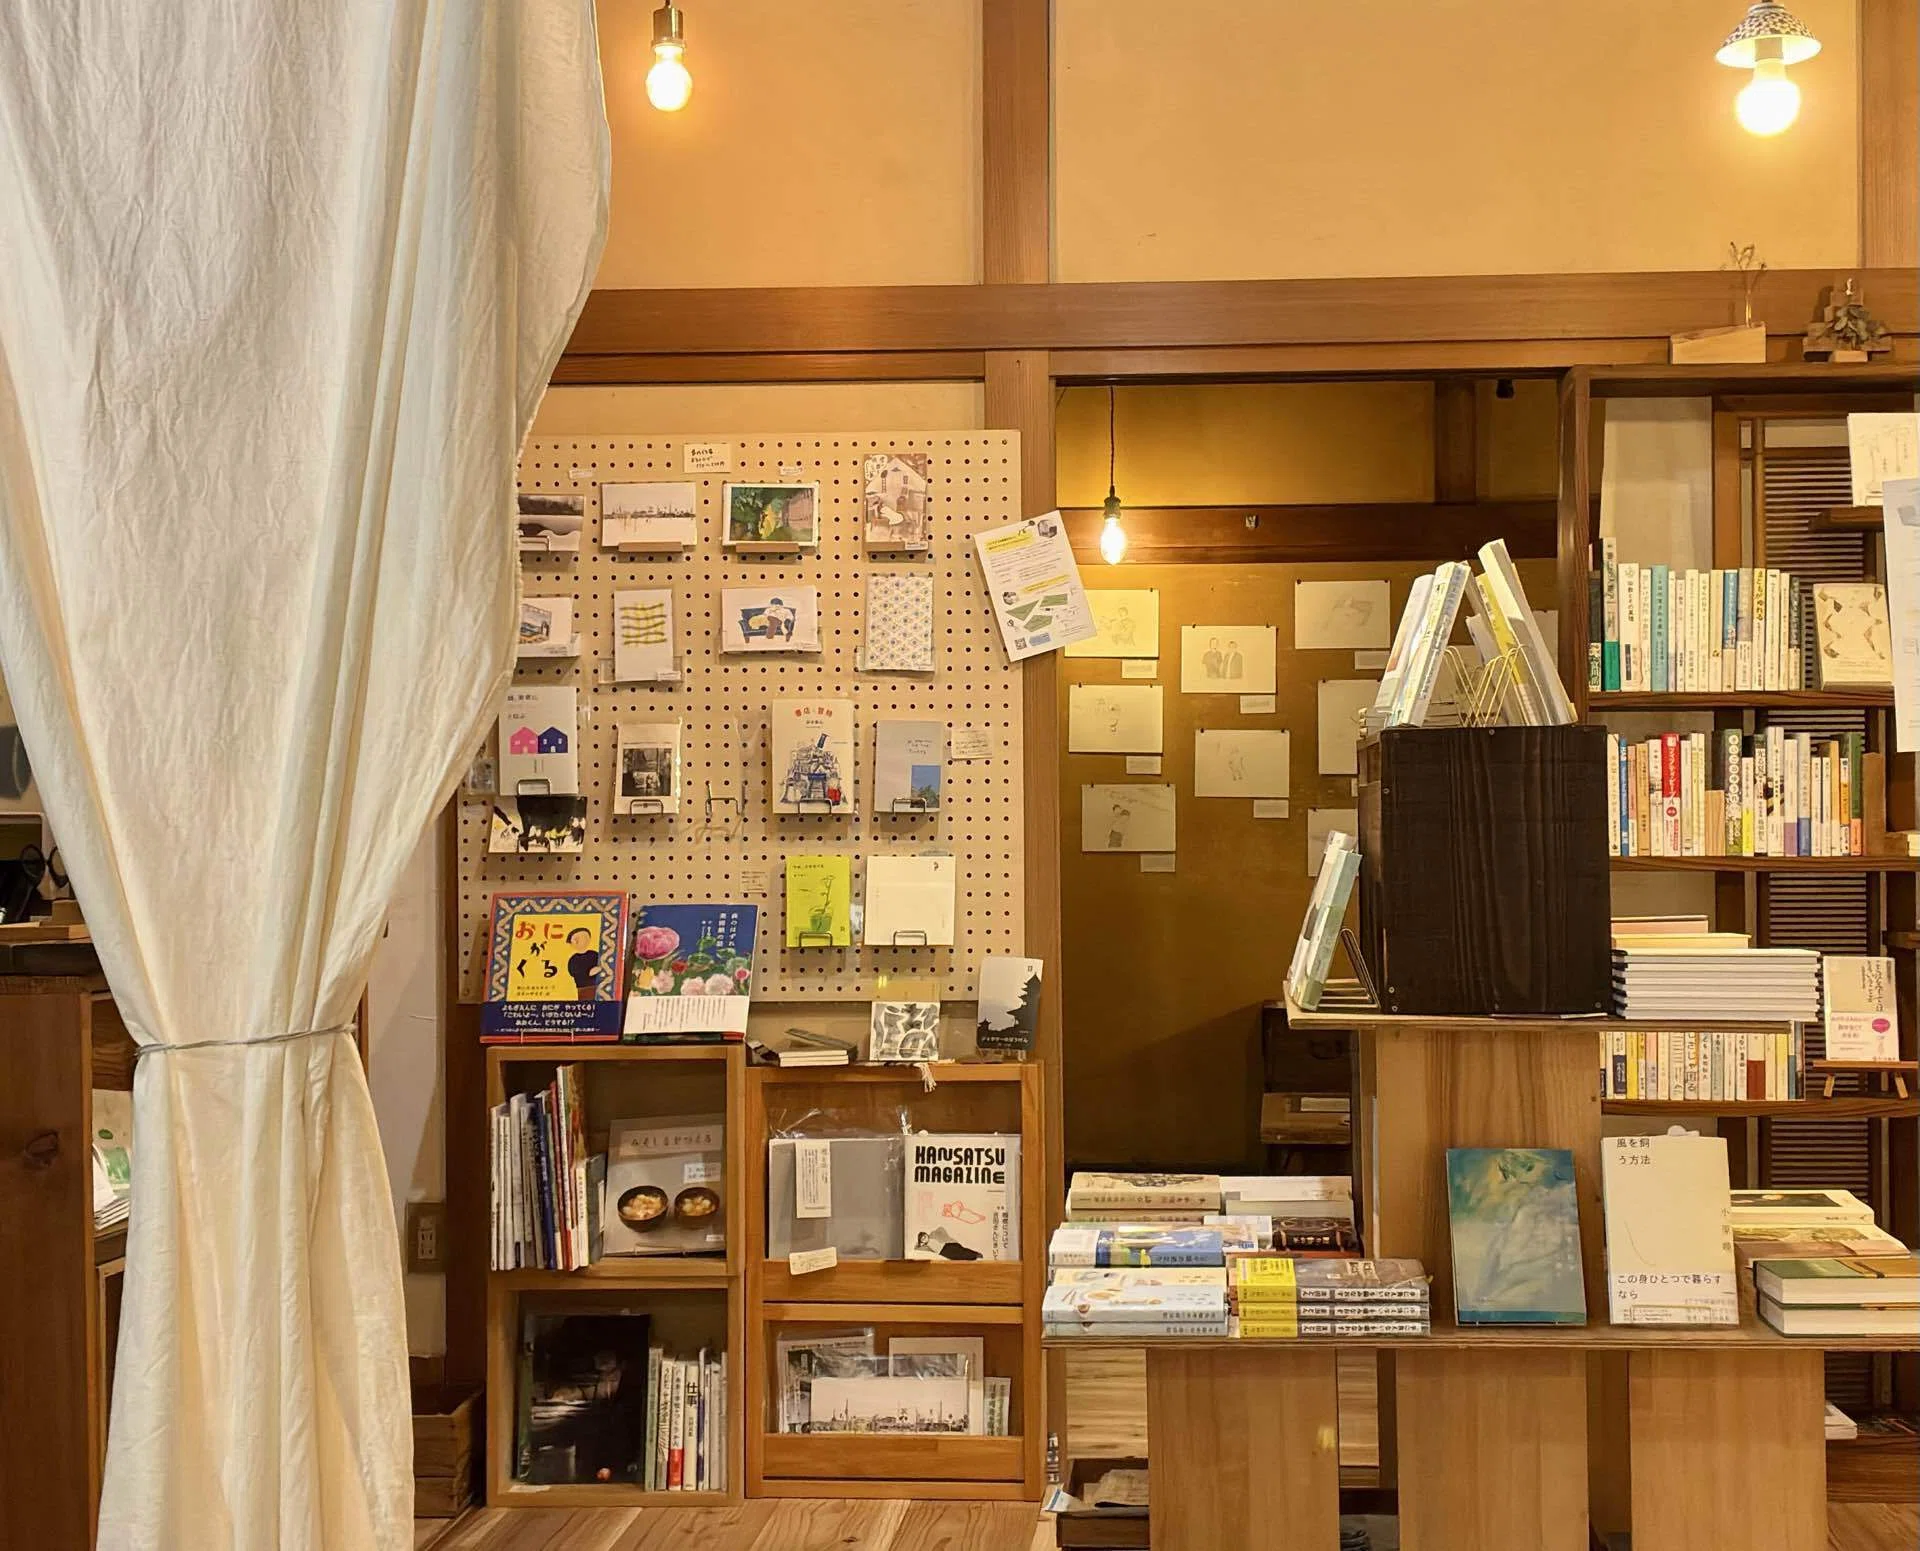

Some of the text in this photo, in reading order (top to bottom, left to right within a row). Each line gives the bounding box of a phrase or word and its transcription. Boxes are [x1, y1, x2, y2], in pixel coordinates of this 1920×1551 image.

[515, 921, 564, 940] おに
[531, 941, 547, 956] が
[517, 959, 558, 978] くる
[1616, 1138, 1650, 1148] 風を飼
[915, 1145, 1005, 1166] HANSATSU
[1619, 1155, 1651, 1166] う方法
[914, 1166, 1005, 1185] MAGAZINE
[1618, 1274, 1721, 1284] この身ひとつで暮らす
[1618, 1290, 1638, 1300] なら
